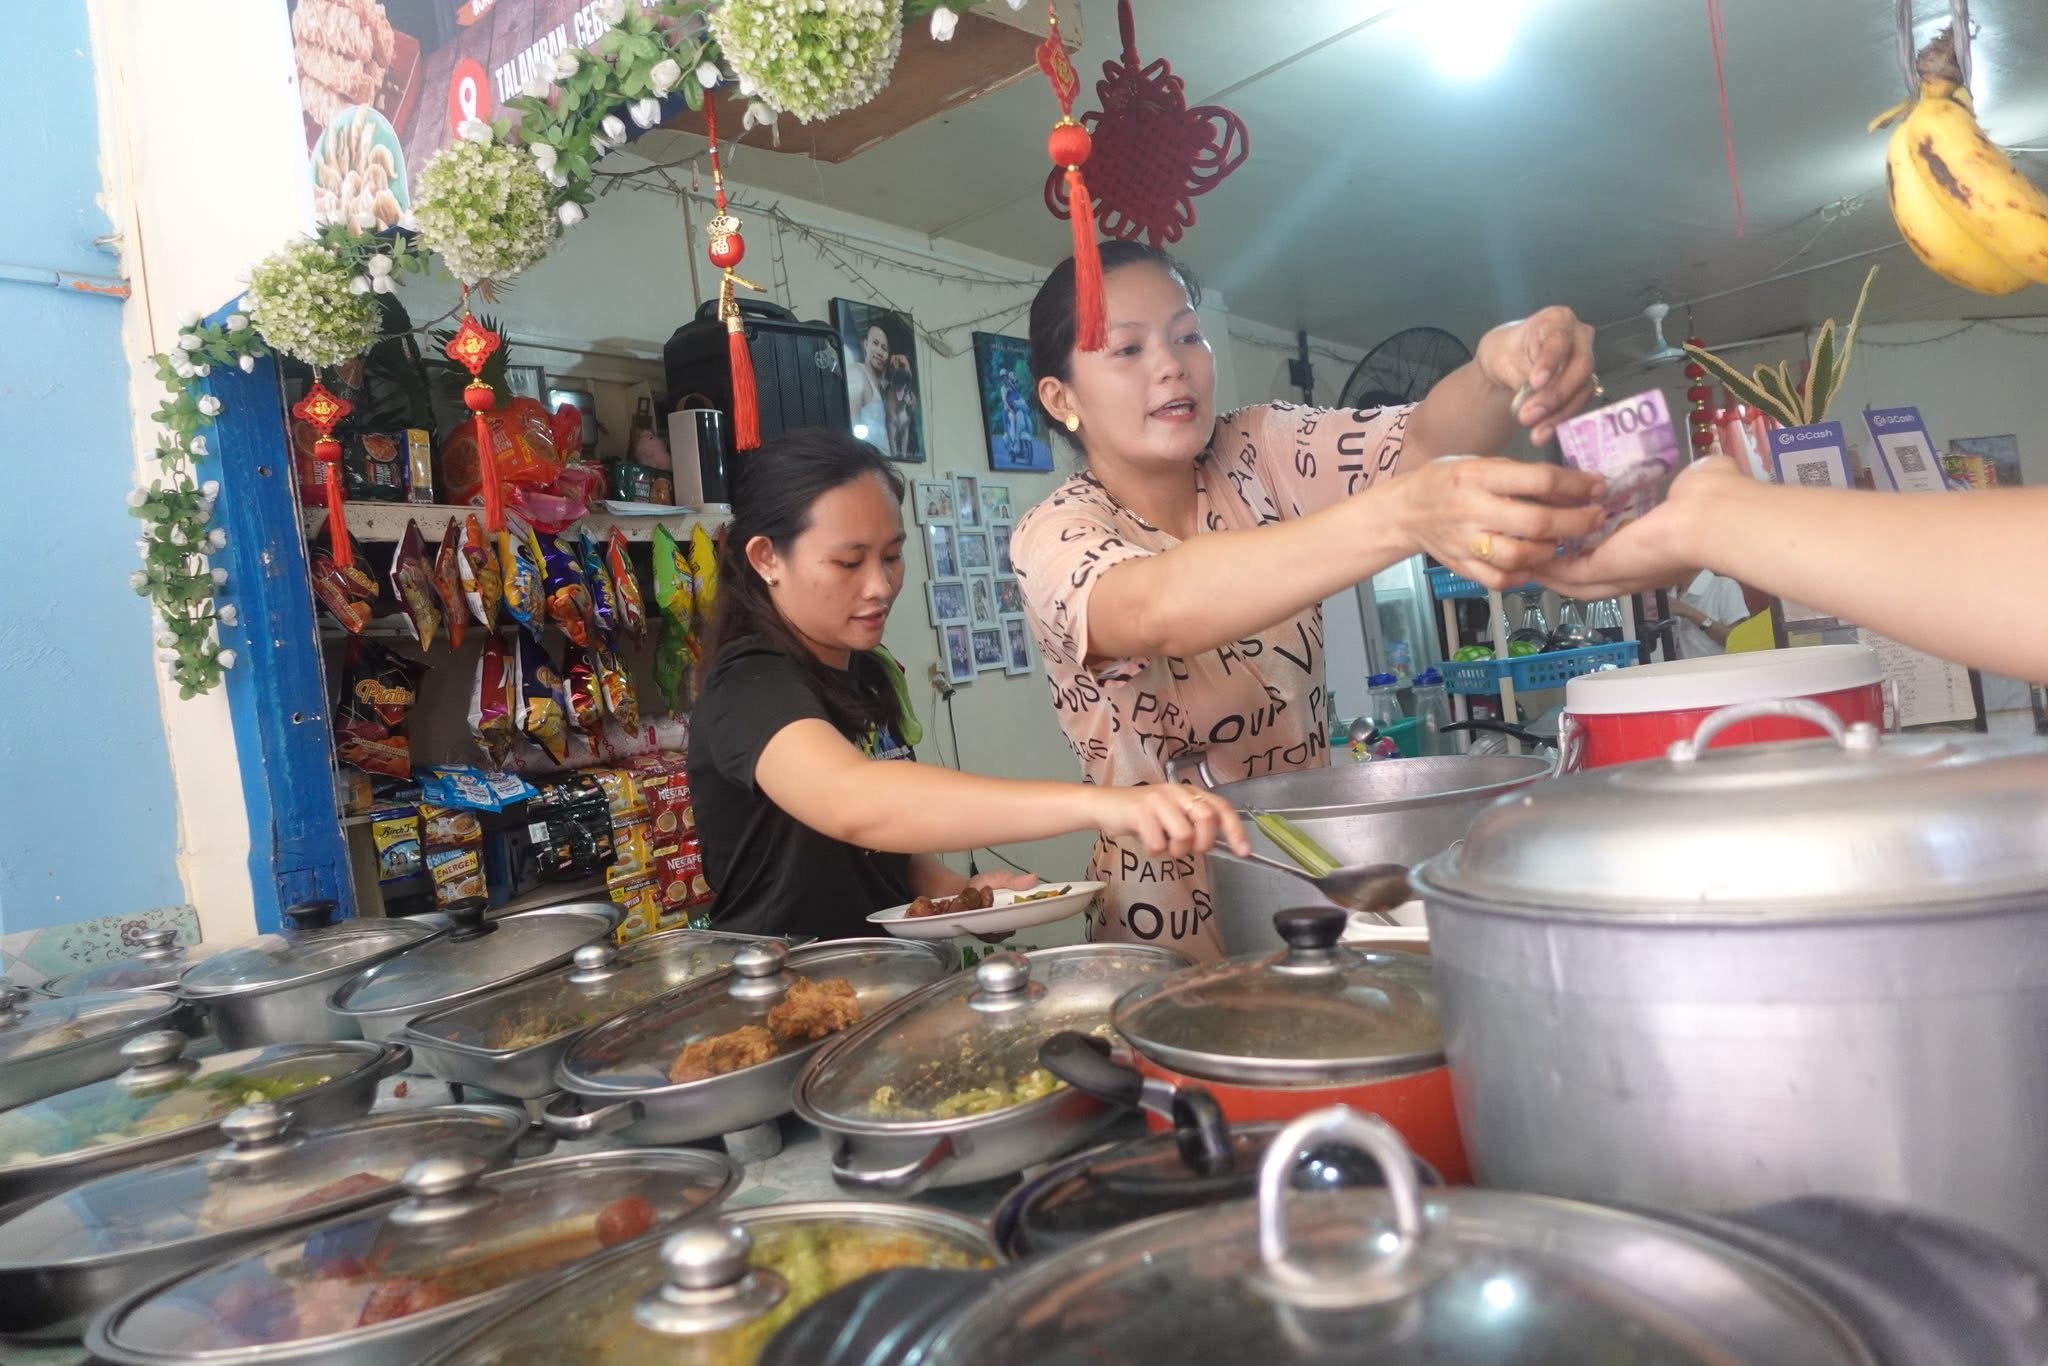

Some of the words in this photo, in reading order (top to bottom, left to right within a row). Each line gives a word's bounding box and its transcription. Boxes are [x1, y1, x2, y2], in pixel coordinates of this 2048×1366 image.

[573, 1, 611, 49] CEB
[1602, 400, 1659, 437] 100
[1887, 414, 1915, 424] GCash
[1796, 429, 1833, 441] GCash
[381, 826, 404, 838] Birch
[436, 858, 477, 879] ENERGEN
[1121, 848, 1195, 883] PARIS
[1119, 889, 1214, 941] OUIS
